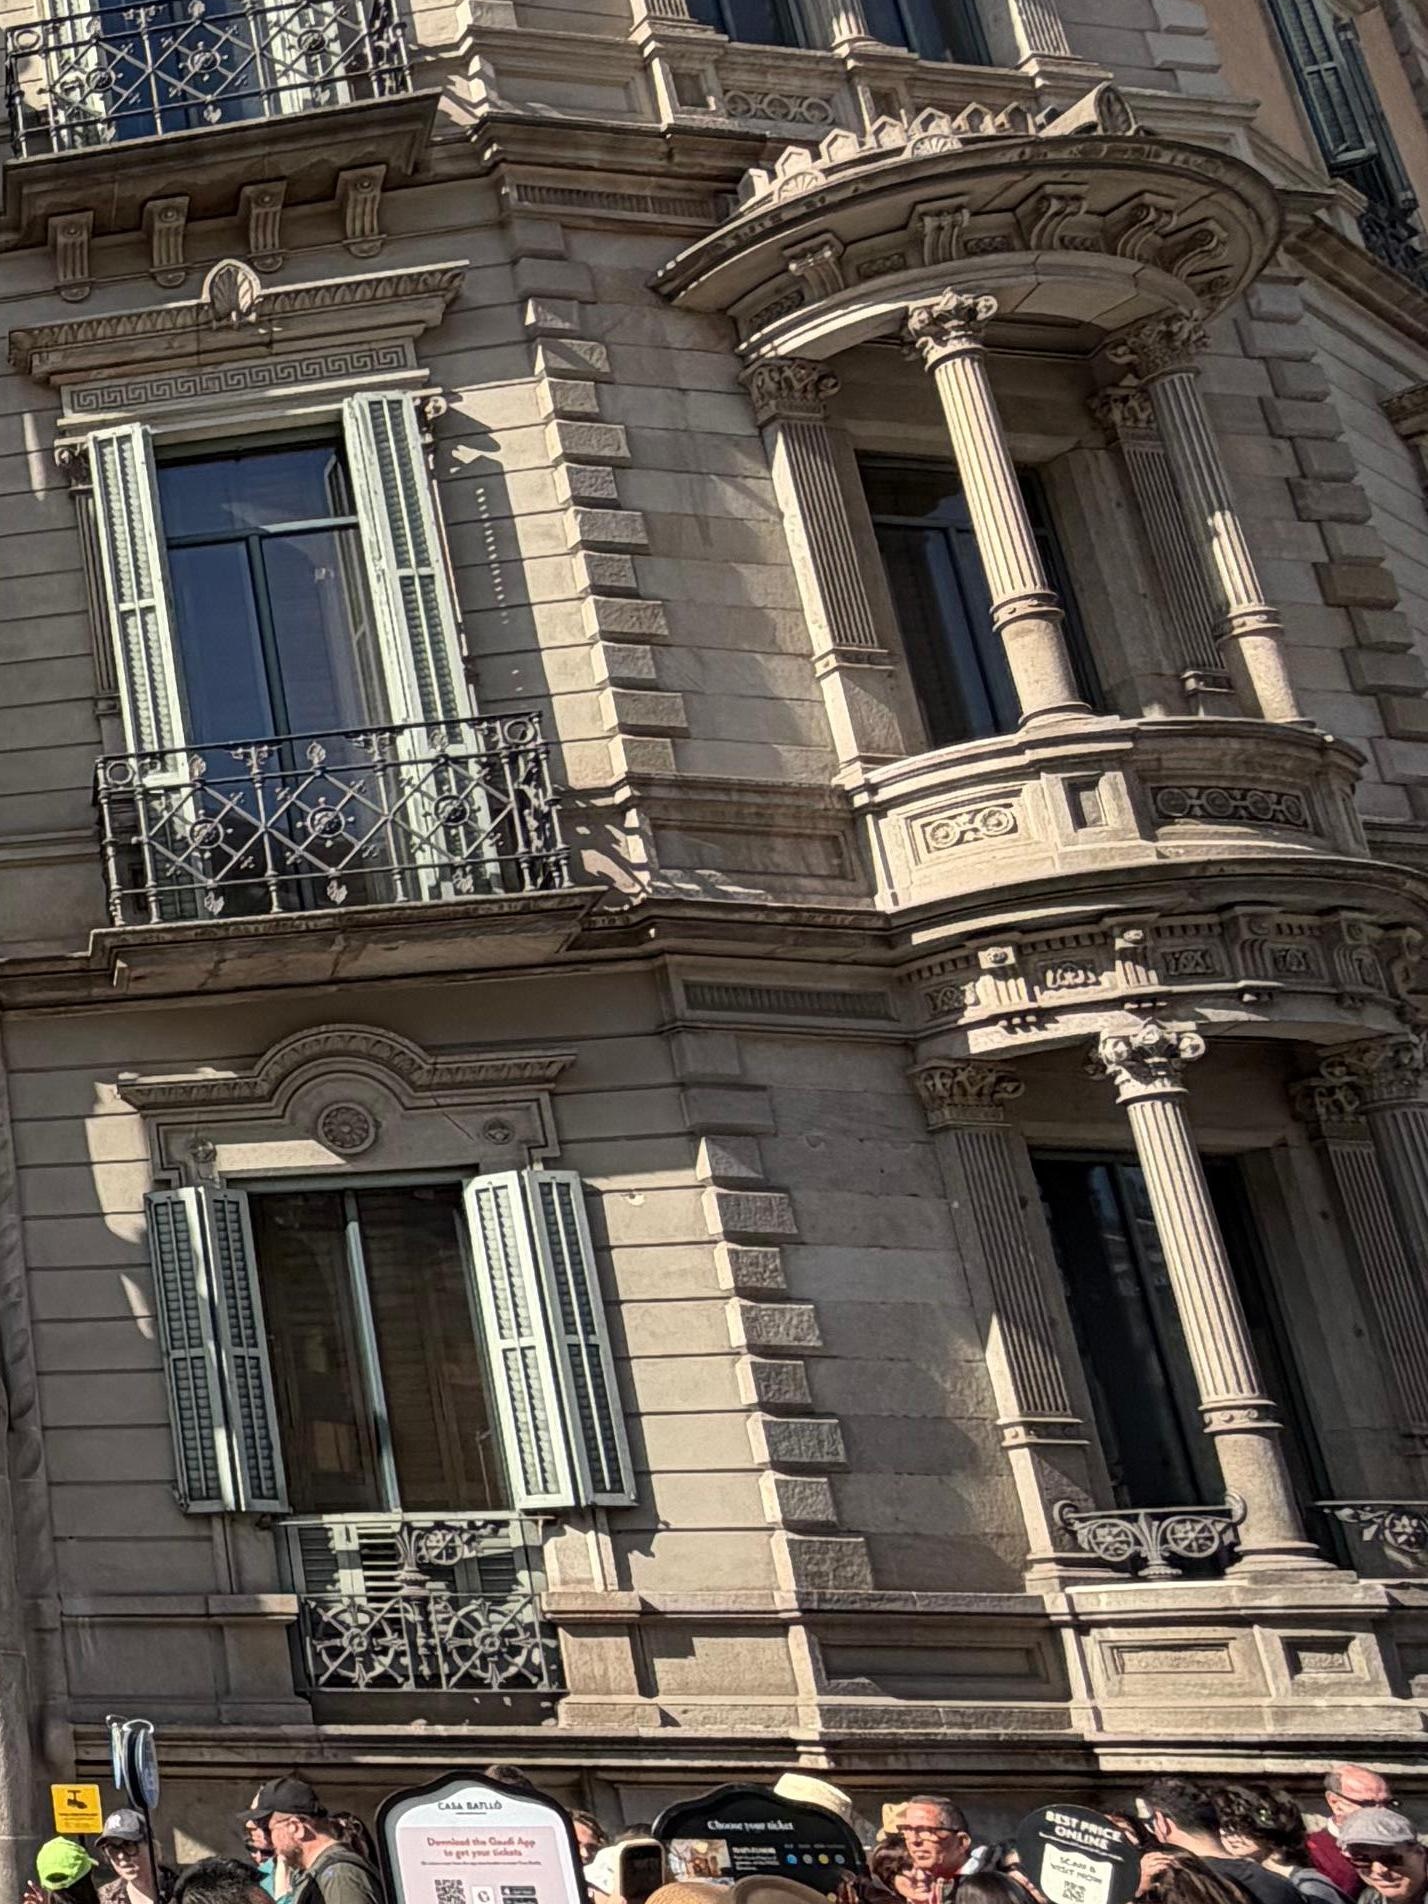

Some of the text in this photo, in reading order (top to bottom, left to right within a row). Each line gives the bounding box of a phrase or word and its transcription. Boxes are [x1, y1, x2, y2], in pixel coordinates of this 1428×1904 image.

[438, 1801, 463, 1811] CASA
[1045, 1810, 1123, 1843] BEST PRICE
[1055, 1825, 1110, 1851] ONLINE
